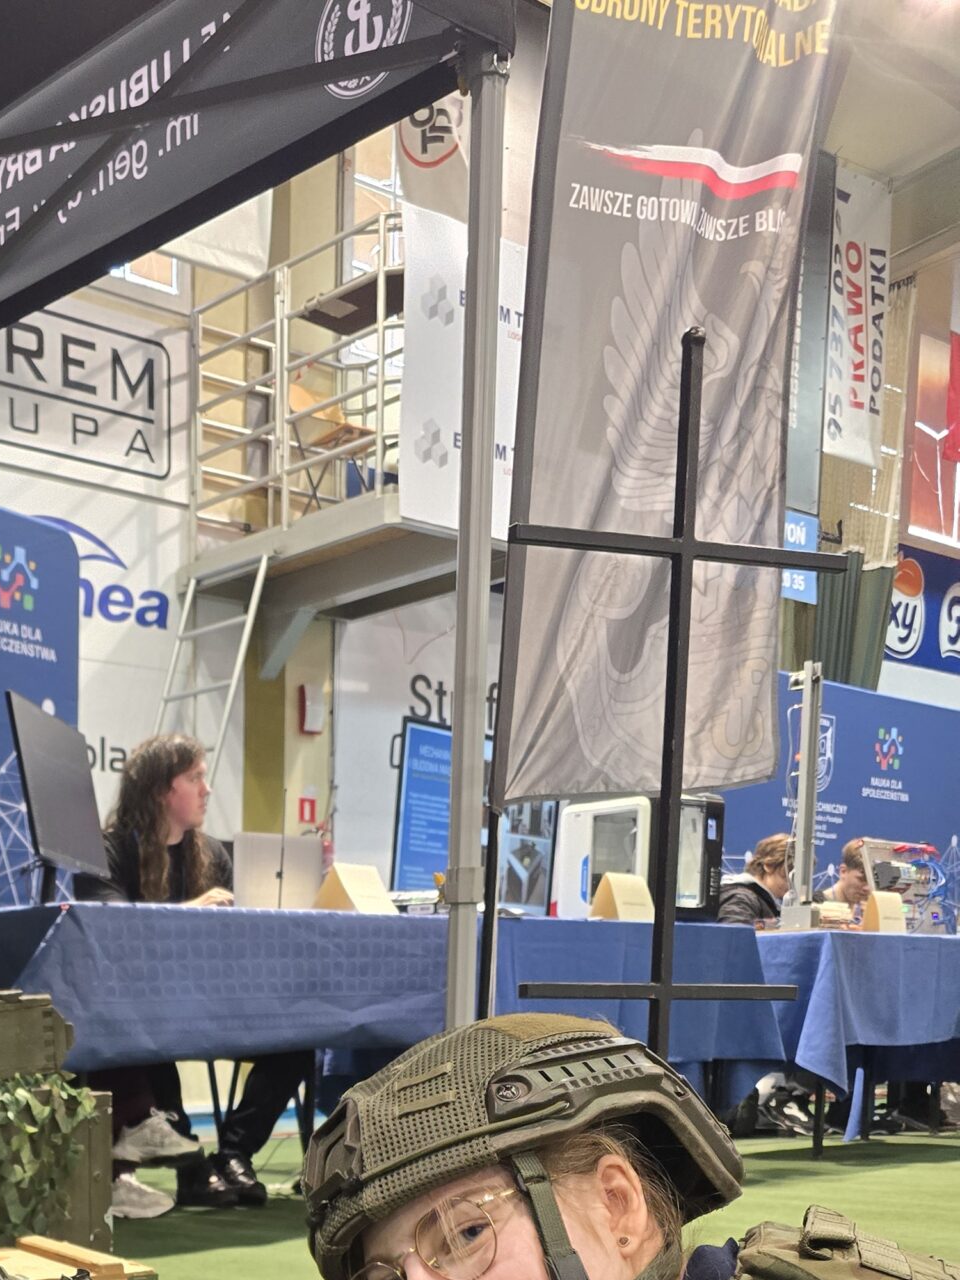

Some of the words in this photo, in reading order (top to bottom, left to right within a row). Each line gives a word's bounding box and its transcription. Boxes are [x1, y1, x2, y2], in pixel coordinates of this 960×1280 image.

[569, 182, 634, 218] ZAWSZE
[696, 207, 750, 242] ZAWSZE
[845, 240, 866, 411] PRAWO
[868, 247, 887, 417] PODATKI
[20, 623, 43, 642] DLA
